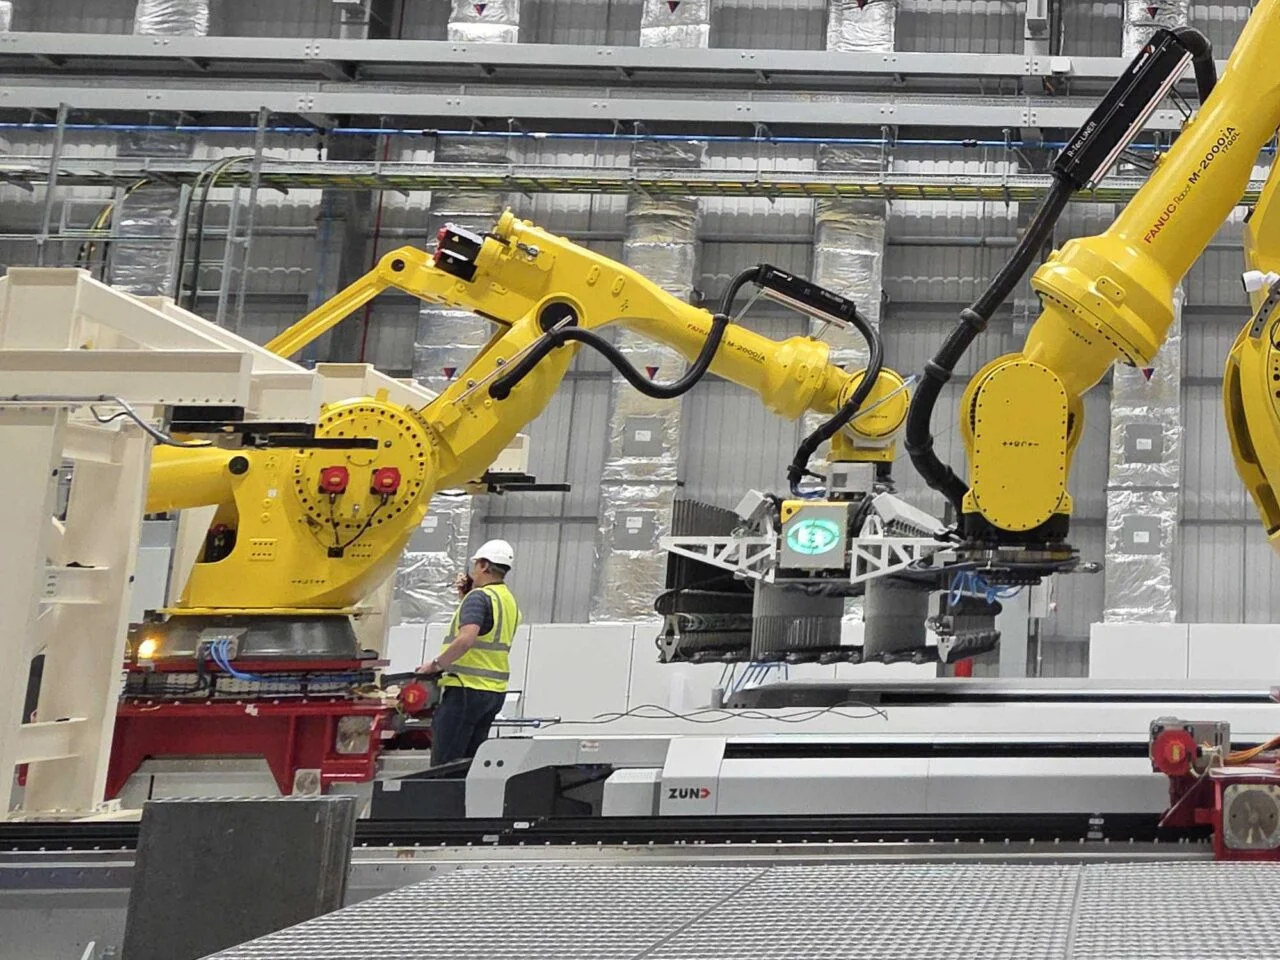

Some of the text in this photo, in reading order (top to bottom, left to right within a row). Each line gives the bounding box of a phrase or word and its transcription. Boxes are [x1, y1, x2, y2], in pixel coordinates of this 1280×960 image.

[1221, 131, 1240, 154] 1700L
[1143, 203, 1178, 244] FANUC
[1188, 126, 1236, 185] M-2000iA
